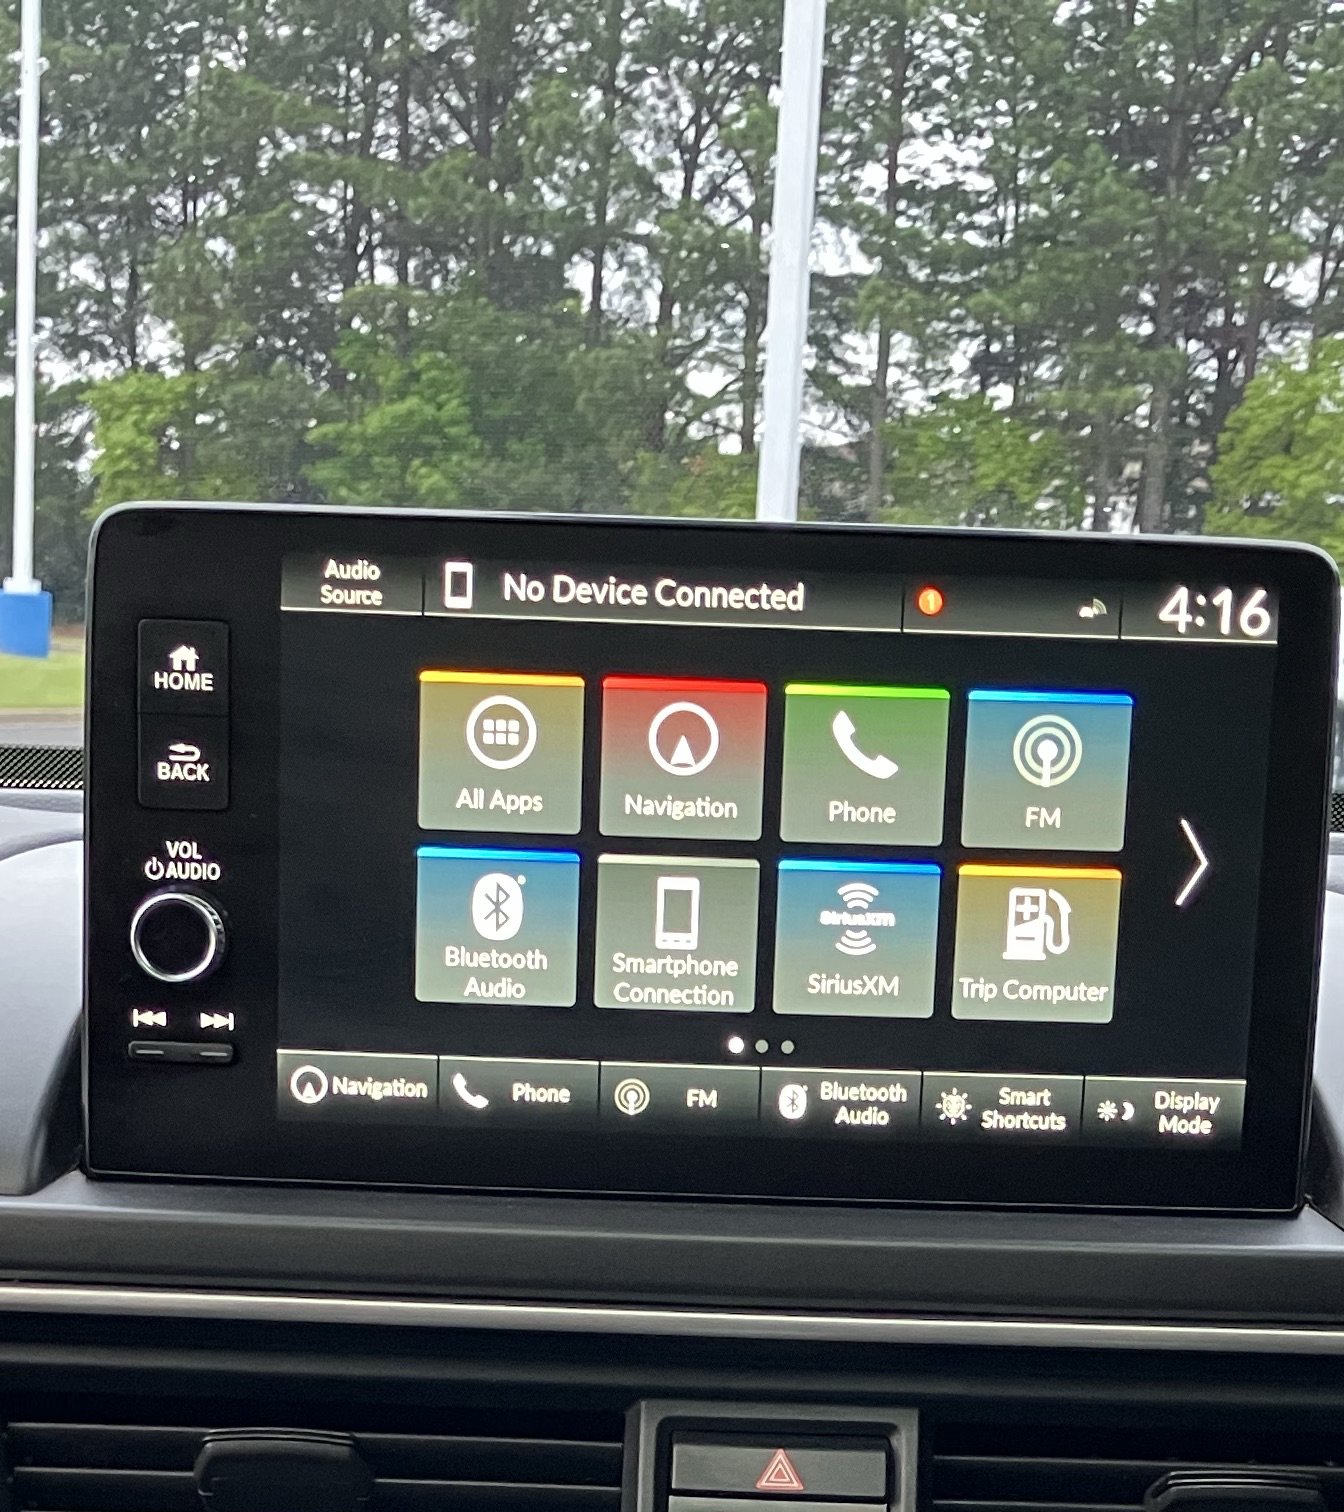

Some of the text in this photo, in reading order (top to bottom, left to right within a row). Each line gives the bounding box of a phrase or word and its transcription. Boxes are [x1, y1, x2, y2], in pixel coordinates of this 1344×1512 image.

[325, 559, 381, 581] Audio
[320, 585, 383, 607] Source
[503, 573, 805, 613] No Device Connected
[1158, 585, 1272, 638] 4:16
[153, 672, 214, 692] HOME
[157, 762, 210, 782] BACK
[456, 788, 543, 814] All Apps
[624, 793, 738, 820] Navigation
[828, 800, 897, 825] Phone
[1025, 807, 1062, 830] FM
[166, 840, 202, 860] VOL
[166, 862, 221, 881] AUDIO
[445, 946, 549, 972] Bluetooth
[612, 951, 739, 983] Smartphone
[464, 976, 526, 999] Audio
[613, 982, 735, 1008] Connection
[807, 973, 900, 998] SiriusXM
[959, 977, 1110, 1005] Trip Computer
[332, 1075, 428, 1101] Navigation
[512, 1083, 571, 1105] Phone
[686, 1090, 718, 1109] FM
[820, 1081, 908, 1105] Bluetooth
[998, 1088, 1052, 1108] Smart
[1154, 1090, 1220, 1116] Display
[835, 1105, 889, 1126] Audio
[981, 1110, 1067, 1133] Shortcuts
[1158, 1115, 1213, 1136] Mode
